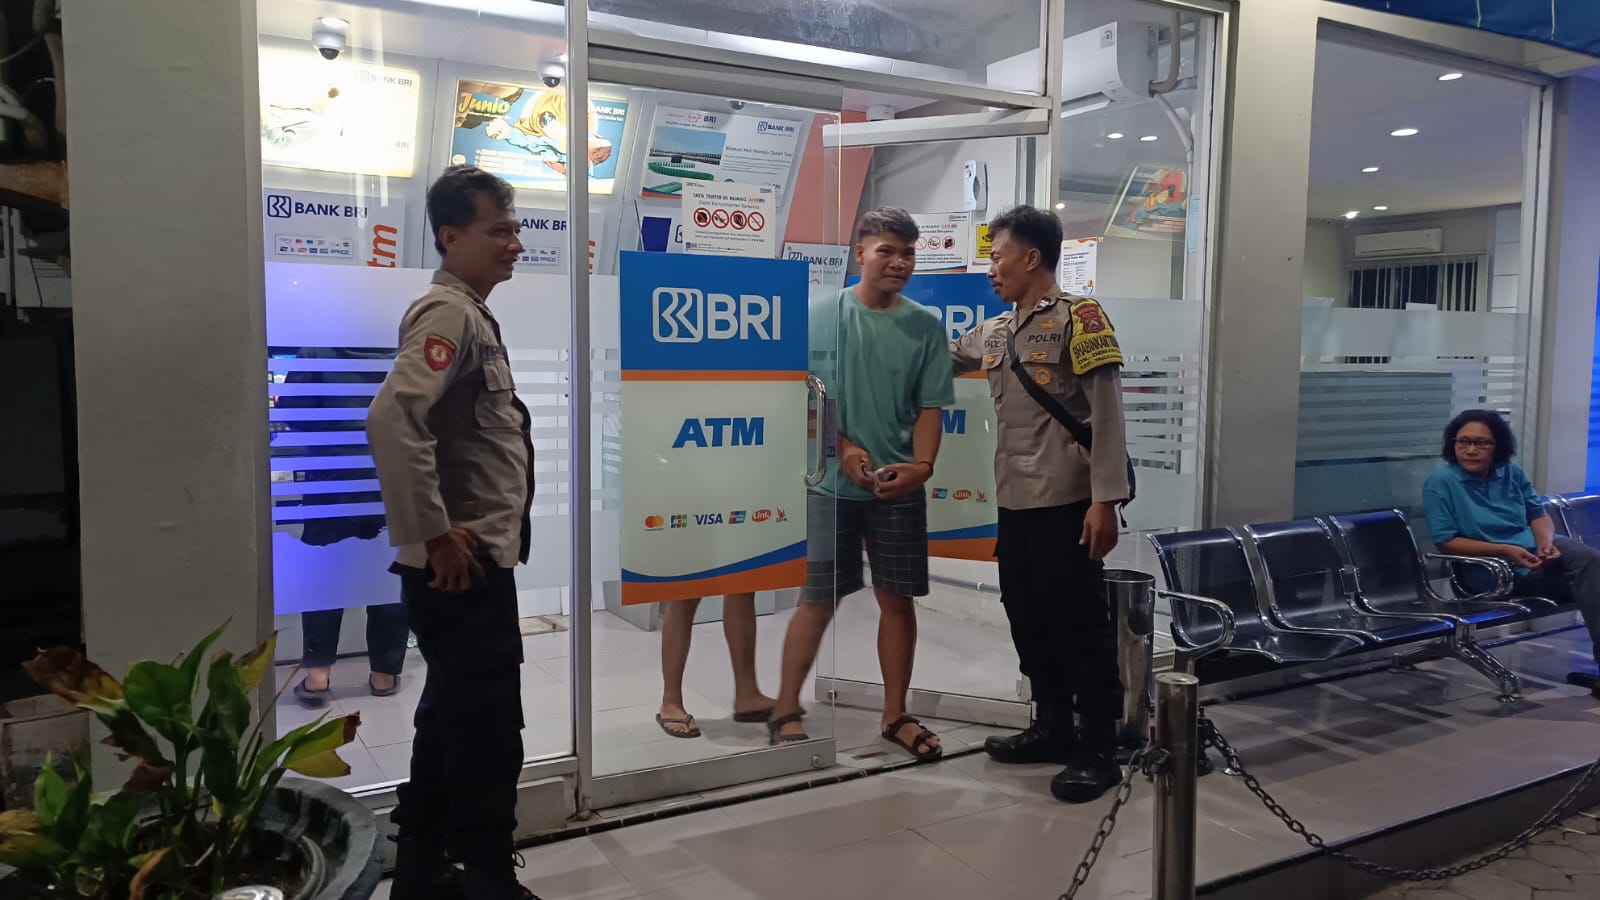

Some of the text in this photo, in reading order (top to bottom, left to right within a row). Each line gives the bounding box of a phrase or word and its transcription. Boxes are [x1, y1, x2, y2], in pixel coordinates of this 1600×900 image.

[398, 78, 412, 86] BRI
[458, 92, 511, 114] Junio
[703, 115, 717, 123] BRI
[294, 202, 368, 219] BANK BRI
[521, 218, 568, 231] ANK BR
[707, 293, 782, 340] BRI
[924, 304, 985, 341] RI
[1027, 333, 1062, 344] POLRI
[672, 417, 765, 448] ATM
[691, 512, 723, 526] VISA
